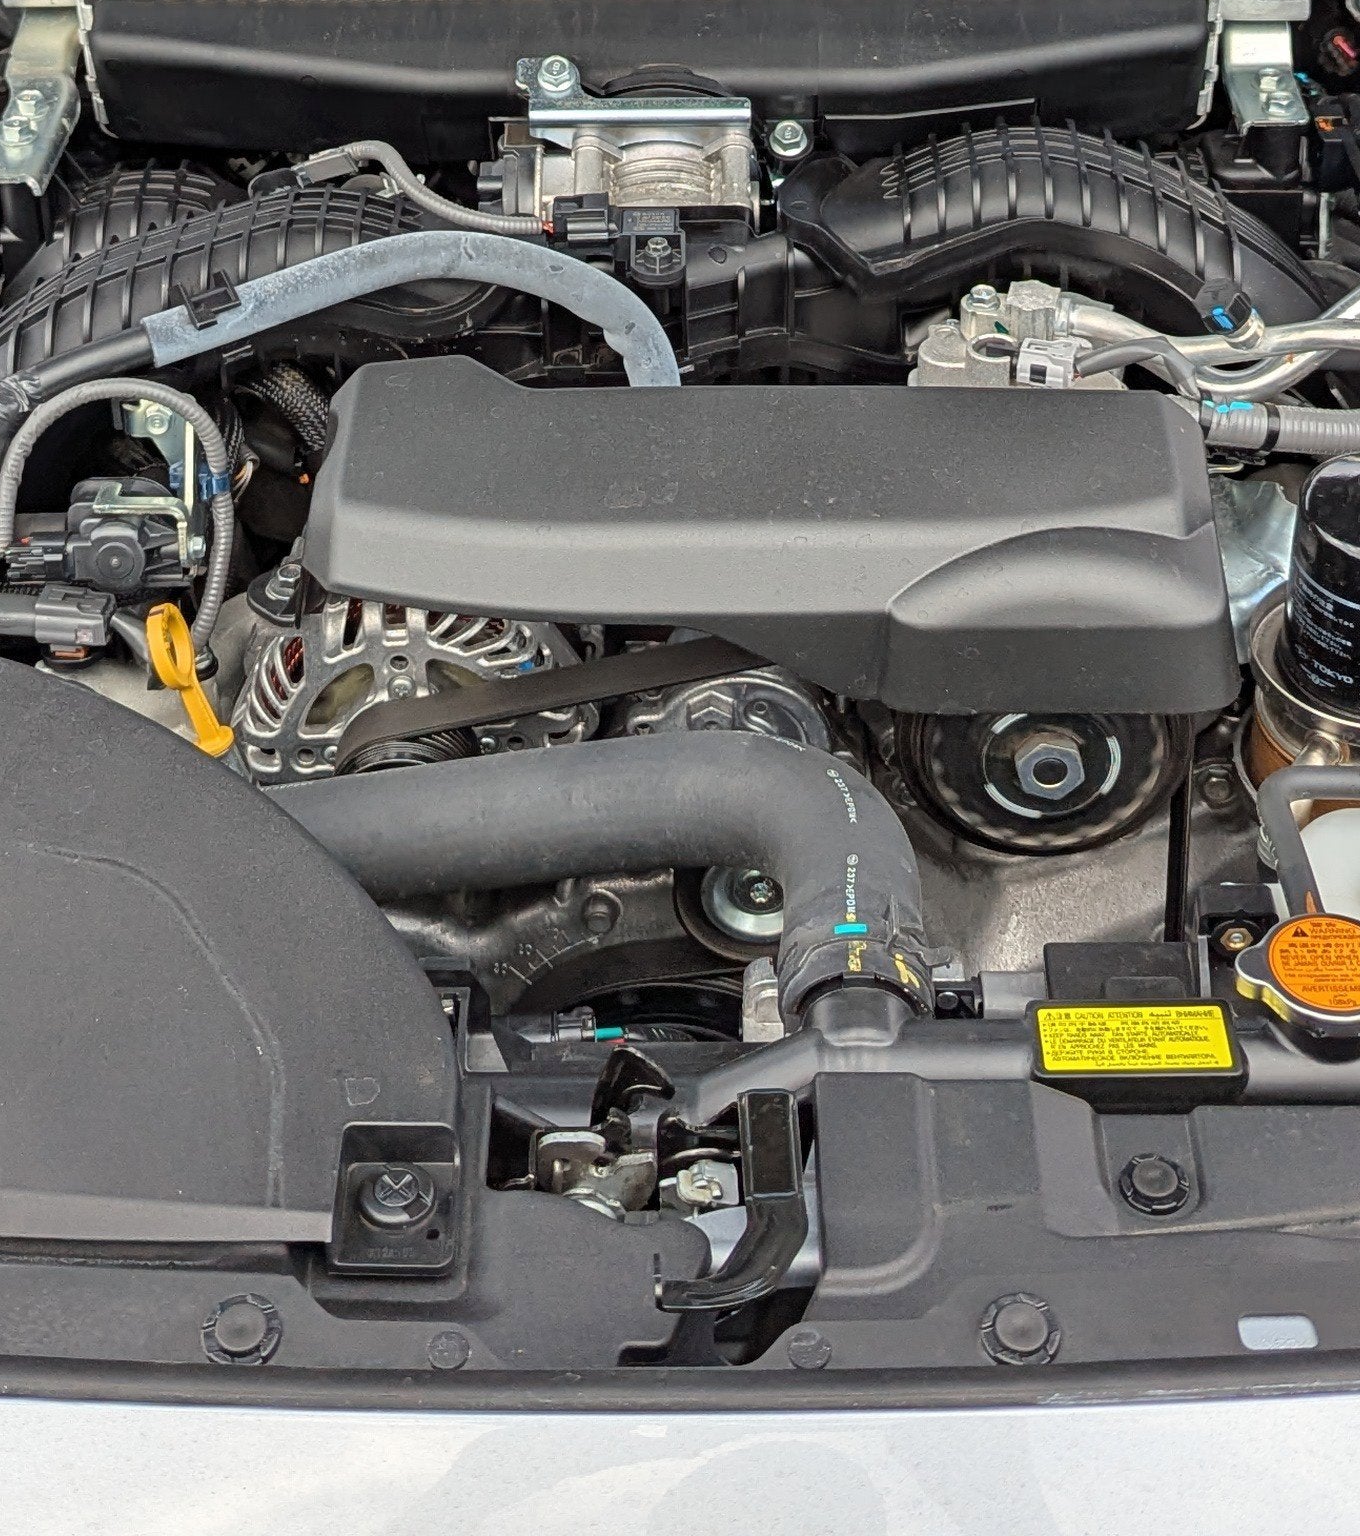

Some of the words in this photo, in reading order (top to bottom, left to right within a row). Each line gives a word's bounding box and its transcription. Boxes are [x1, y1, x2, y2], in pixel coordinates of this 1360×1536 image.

[1311, 659, 1354, 685] TOKYO
[1074, 1012, 1104, 1020] CAUTION
[1107, 1011, 1143, 1019] ATTENTION
